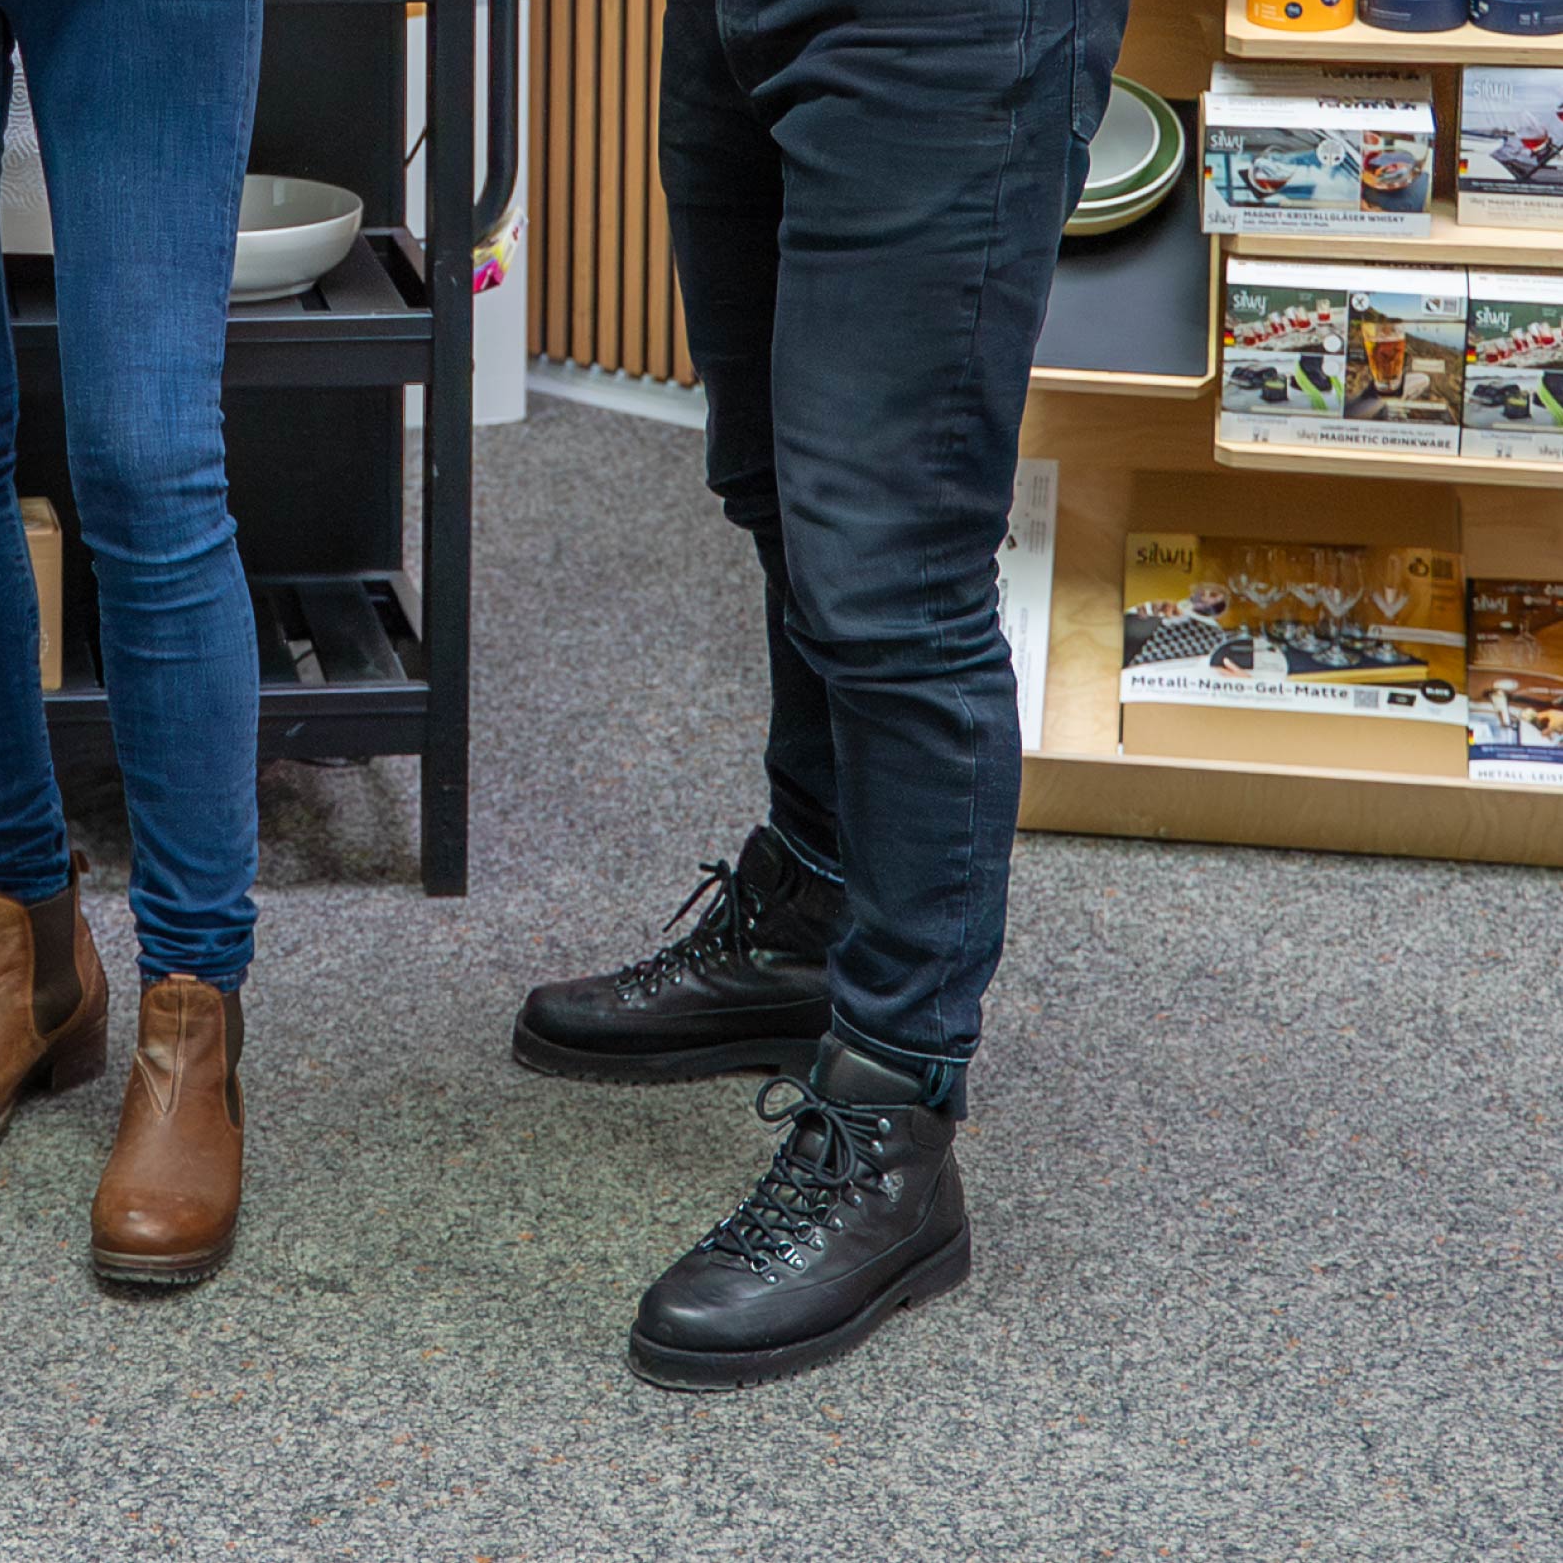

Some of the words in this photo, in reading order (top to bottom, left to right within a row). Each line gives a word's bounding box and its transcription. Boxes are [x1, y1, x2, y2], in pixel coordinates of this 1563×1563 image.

[1209, 130, 1244, 155] silwy
[1367, 214, 1405, 224] WHISKY
[1232, 290, 1268, 316] silwy
[1475, 306, 1511, 333] silwy
[1319, 432, 1379, 445] MAGNETIC
[1381, 437, 1452, 450] DRINKWARE
[1136, 540, 1196, 575] silwy
[1130, 674, 1351, 700] Metall-Nano-Gel-Matte
